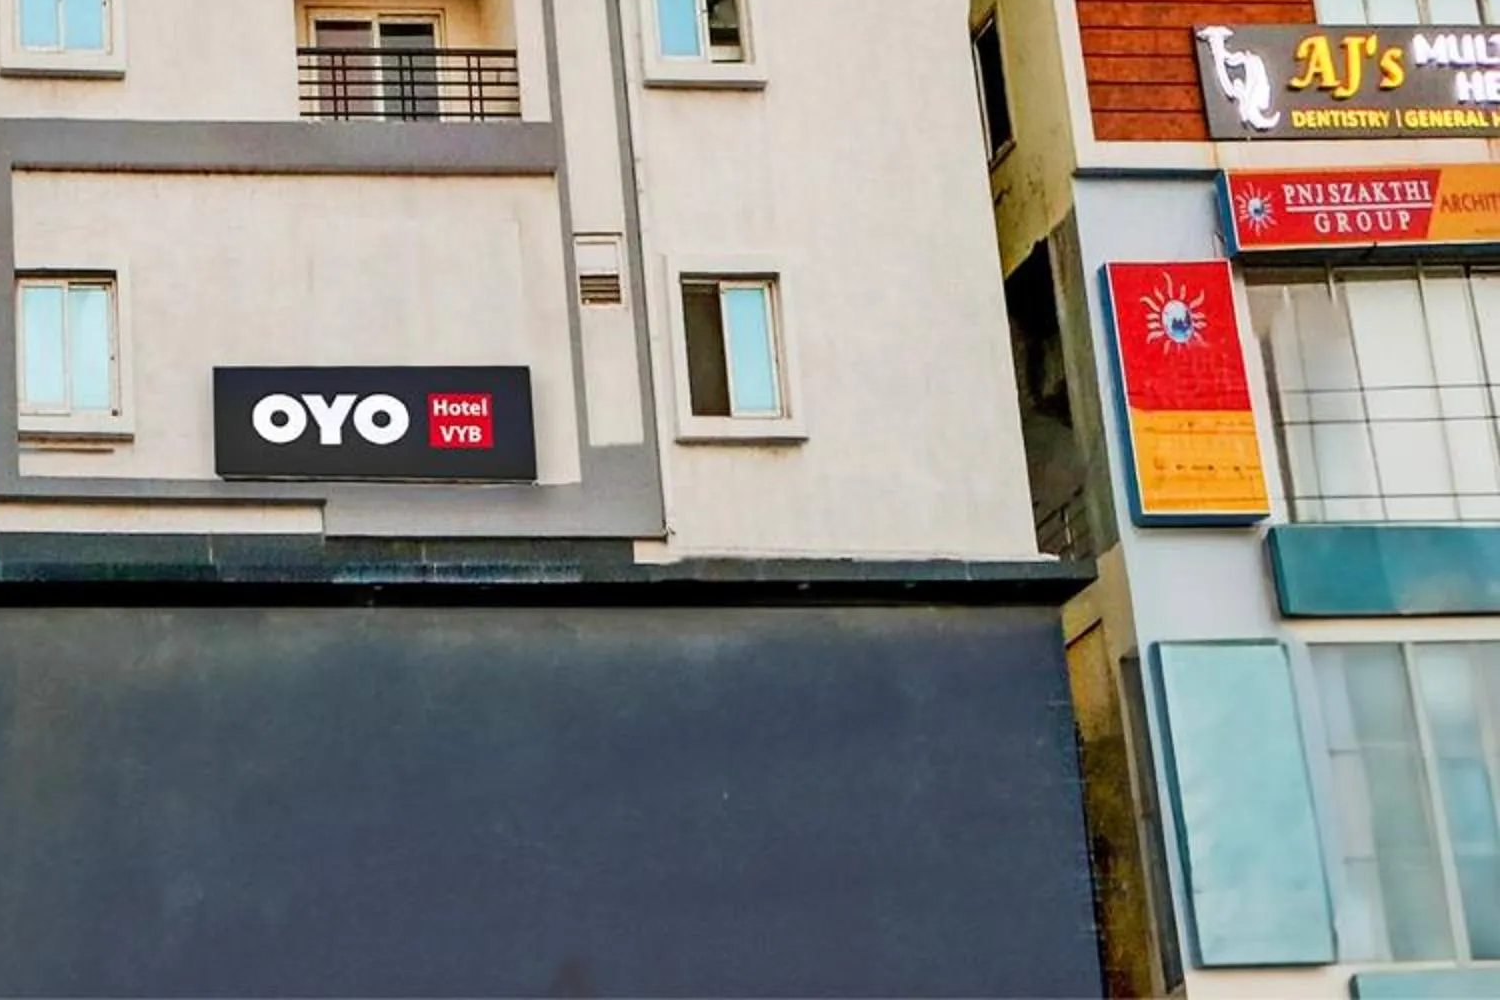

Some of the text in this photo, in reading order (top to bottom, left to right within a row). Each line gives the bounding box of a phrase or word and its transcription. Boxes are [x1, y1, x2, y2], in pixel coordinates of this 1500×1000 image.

[1288, 34, 1405, 99] AJ's
[1291, 110, 1390, 128] DENTISTRY
[1404, 110, 1489, 128] GENERAL
[1314, 210, 1411, 234] GROUP
[432, 398, 488, 417] Hotel
[252, 393, 410, 445] OYO
[439, 424, 482, 443] VYB
